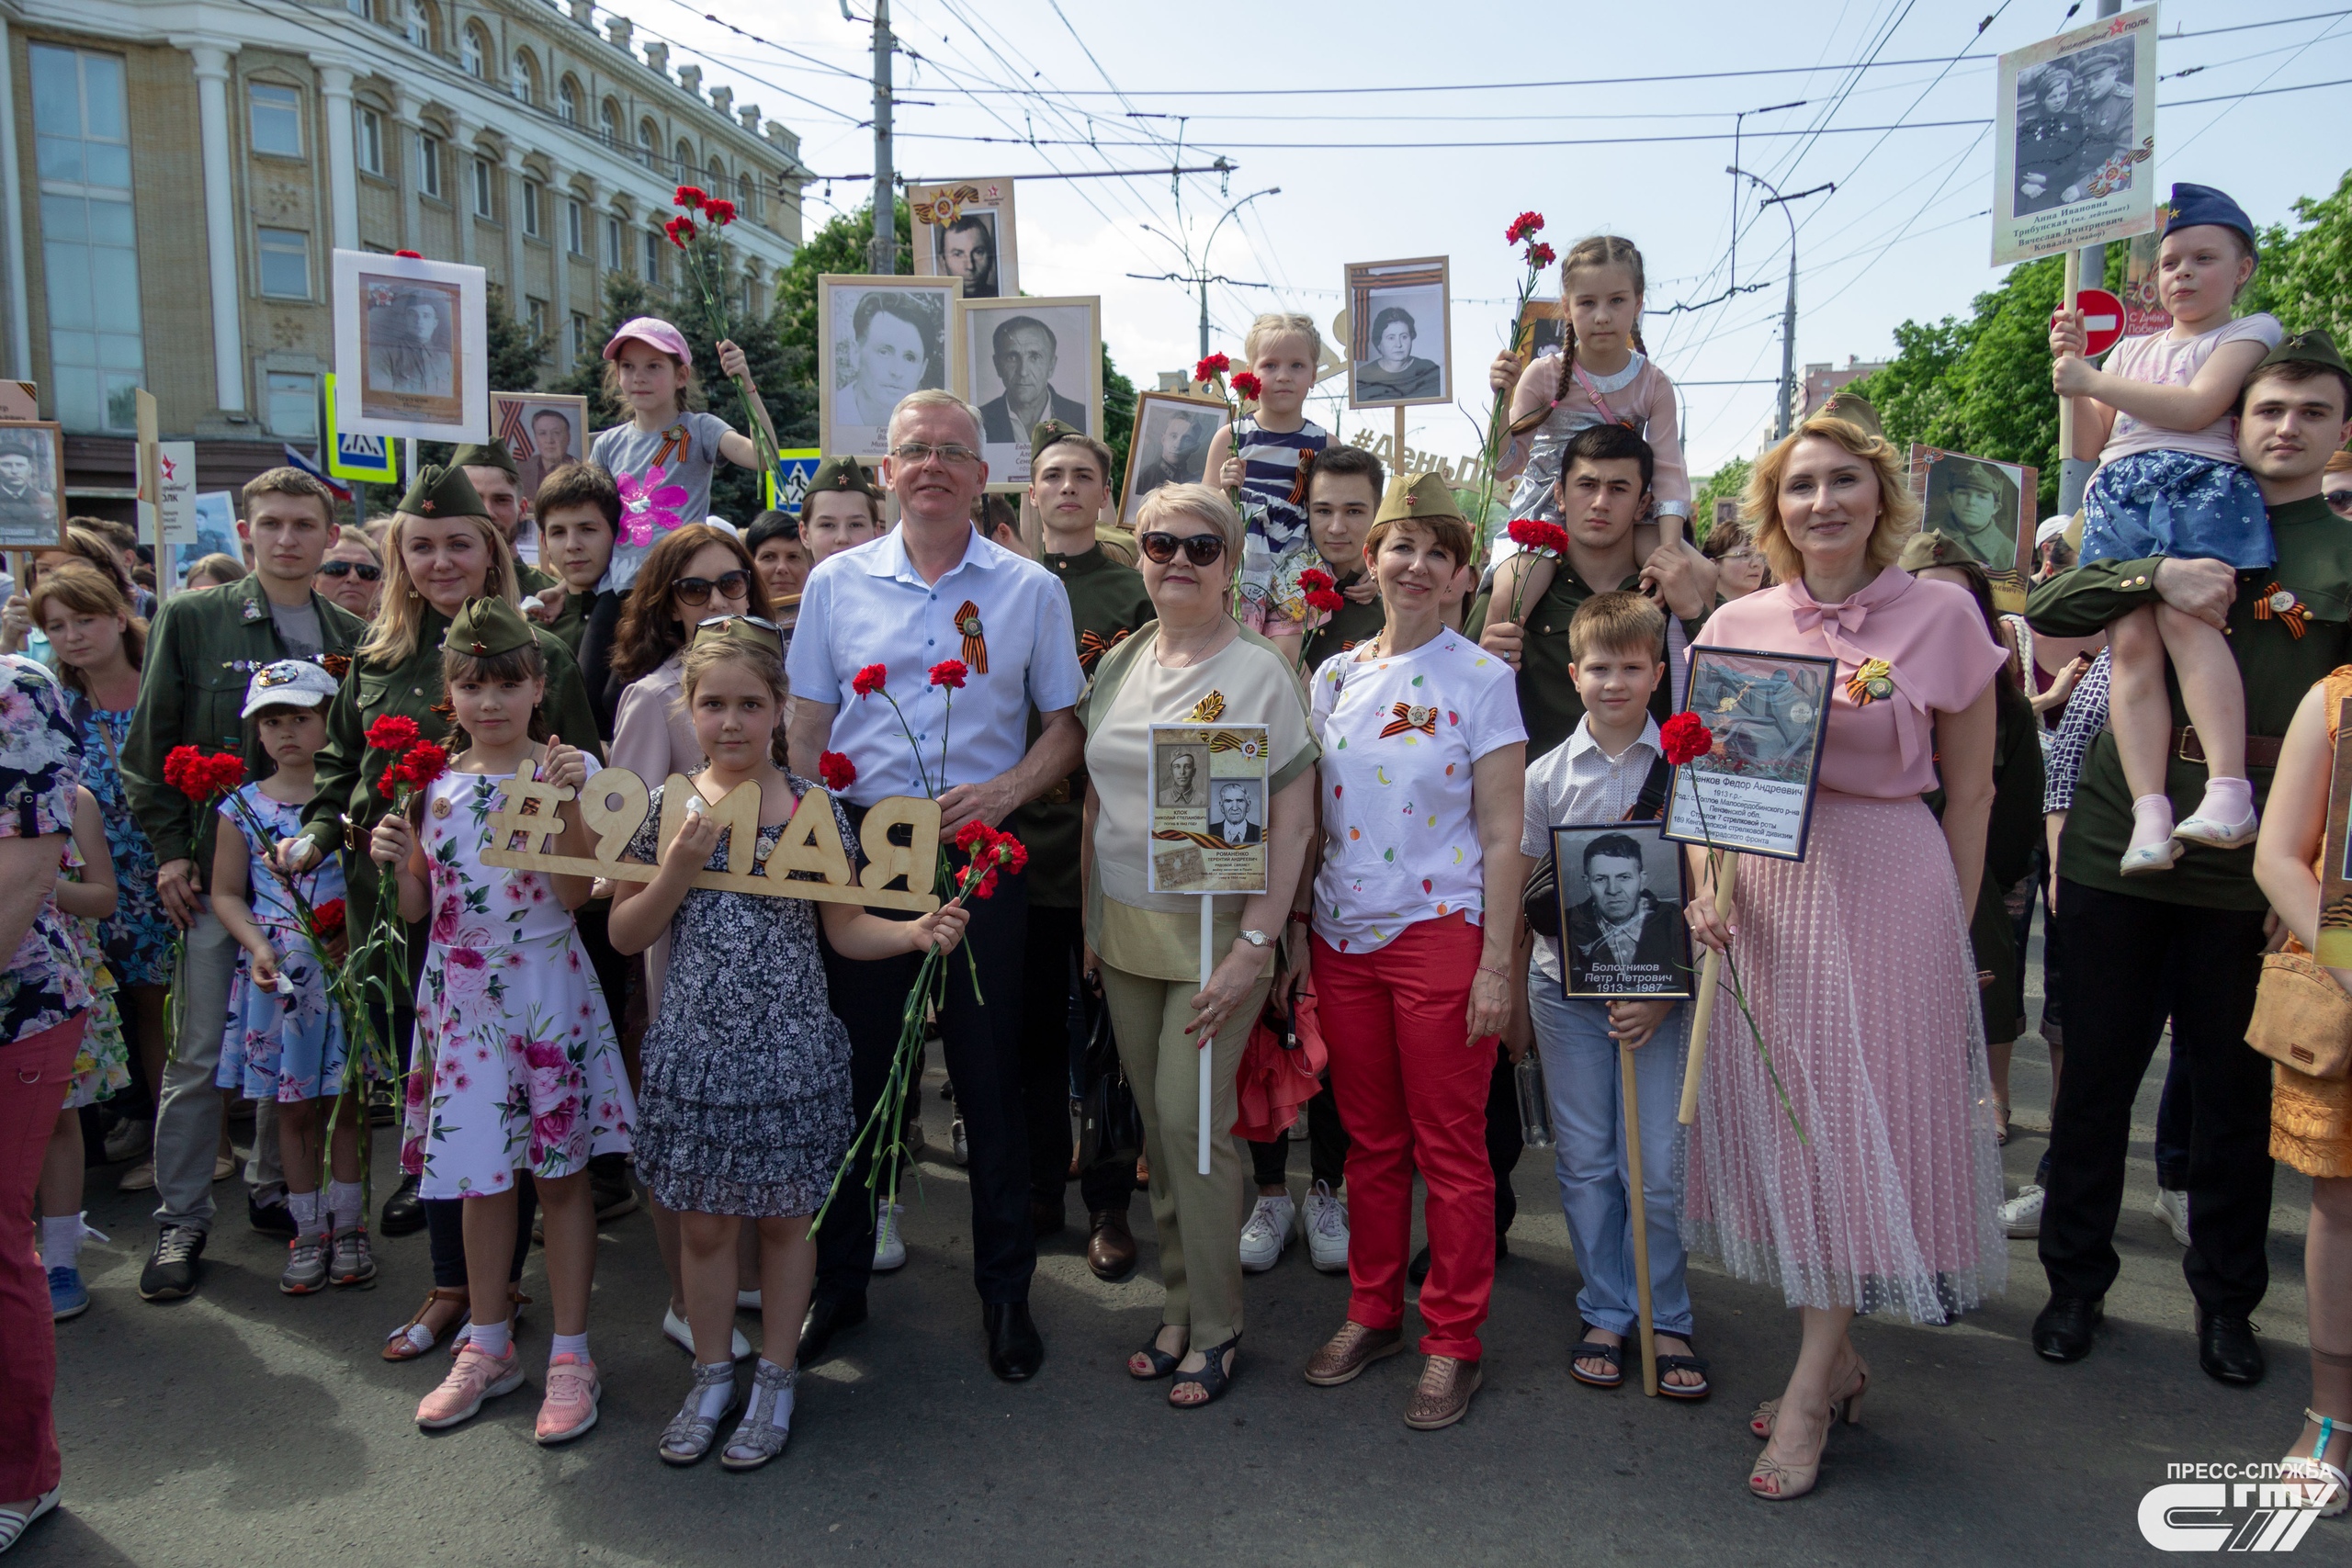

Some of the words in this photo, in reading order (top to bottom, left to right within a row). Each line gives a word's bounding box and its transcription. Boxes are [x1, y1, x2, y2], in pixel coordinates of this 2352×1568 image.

[2124, 17, 2150, 31] ПОЛК
[2033, 212, 2057, 224] Анна
[2061, 199, 2108, 217] Ивановна
[2013, 219, 2067, 238] Трибунская
[2018, 231, 2061, 247] Вячеслав
[2063, 217, 2123, 237] Дмитриевич
[2034, 236, 2073, 252] Ковалёв
[2075, 230, 2106, 243] (майор)
[2128, 310, 2138, 323] С
[1713, 789, 1728, 797] 1913
[1753, 781, 1803, 796] Андреевич
[1709, 805, 1746, 817] Пензенской
[1747, 810, 1761, 818] обл.
[483, 758, 943, 898] #9МАЯ
[1723, 816, 1759, 827] стрелковой
[1760, 821, 1777, 829] роты
[1728, 824, 1764, 837] стрелковой
[1765, 829, 1793, 840] дивизии
[1745, 834, 1770, 845] фронта
[1591, 963, 1659, 972] Болотников
[1584, 973, 1613, 984] Петр
[1616, 973, 1672, 984] Петрович
[1596, 983, 1623, 993] 1913
[1634, 983, 1663, 993] 1987
